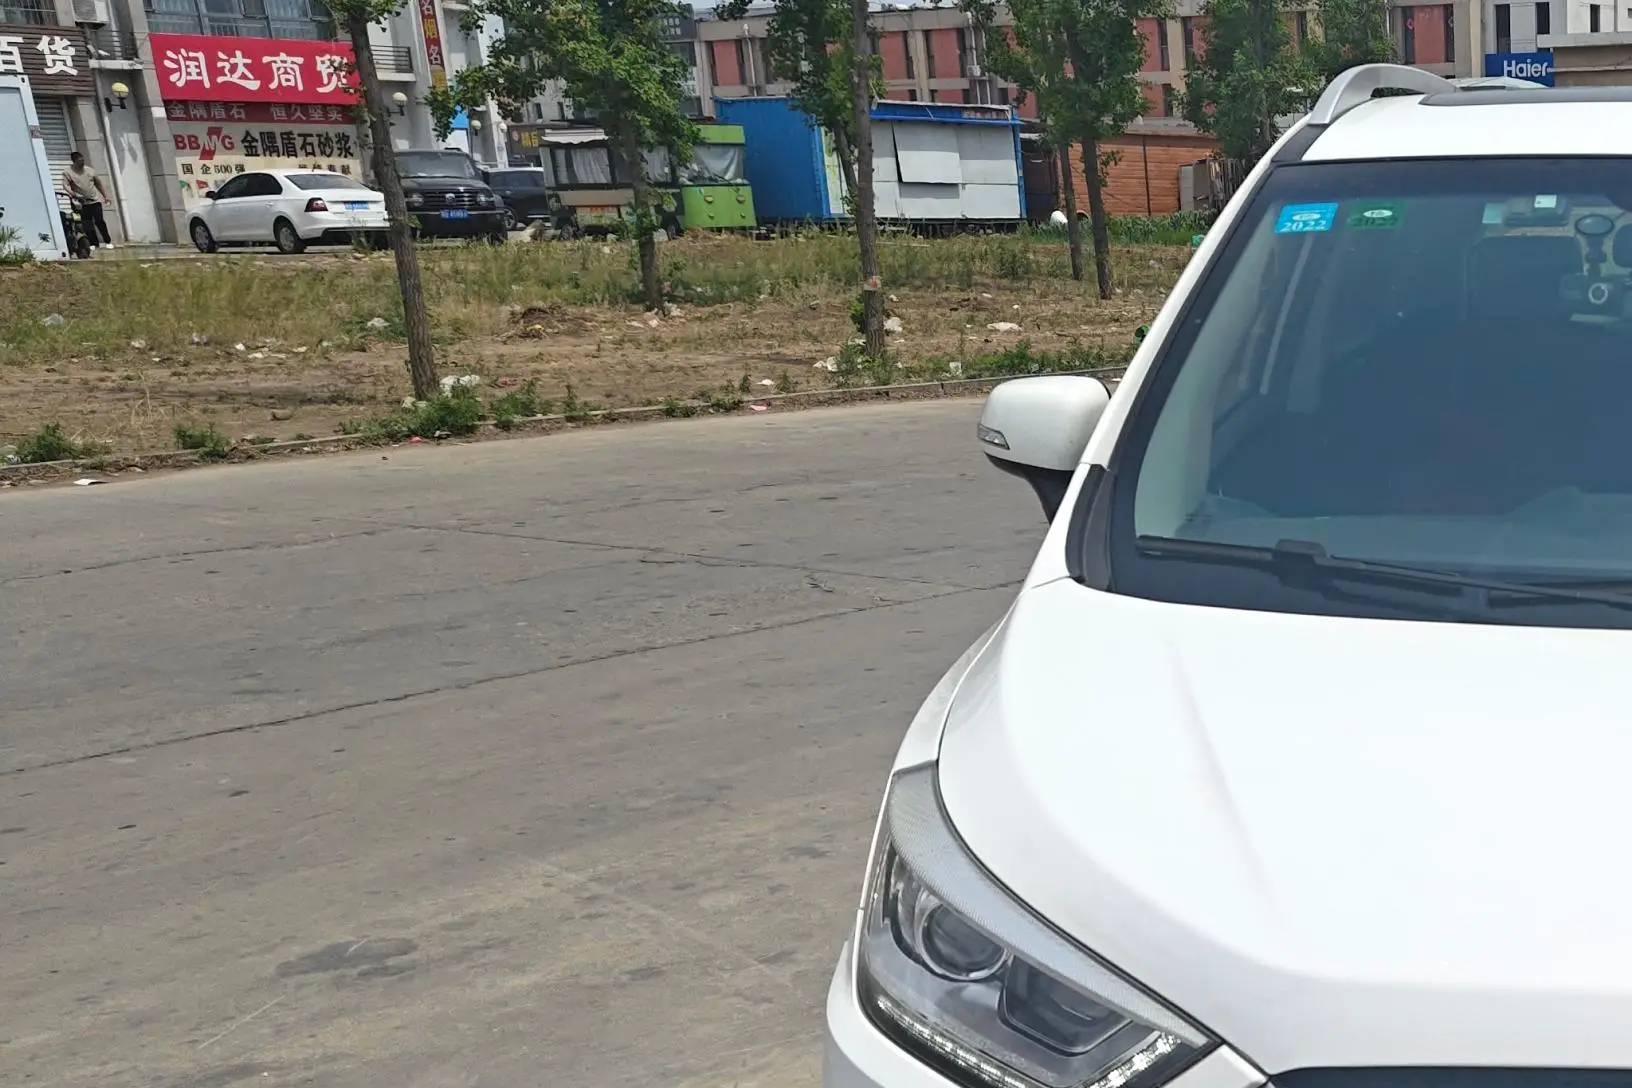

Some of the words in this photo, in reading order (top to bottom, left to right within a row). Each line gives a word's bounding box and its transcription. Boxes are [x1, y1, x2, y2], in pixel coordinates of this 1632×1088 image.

[164, 48, 354, 93] 润达商贸
[1503, 59, 1547, 78] Haier
[168, 101, 247, 120] 金隅盾石
[269, 104, 343, 122] 恒久坚实
[240, 130, 355, 159] 金隅盾石砂浆
[1280, 220, 1328, 232] 2022
